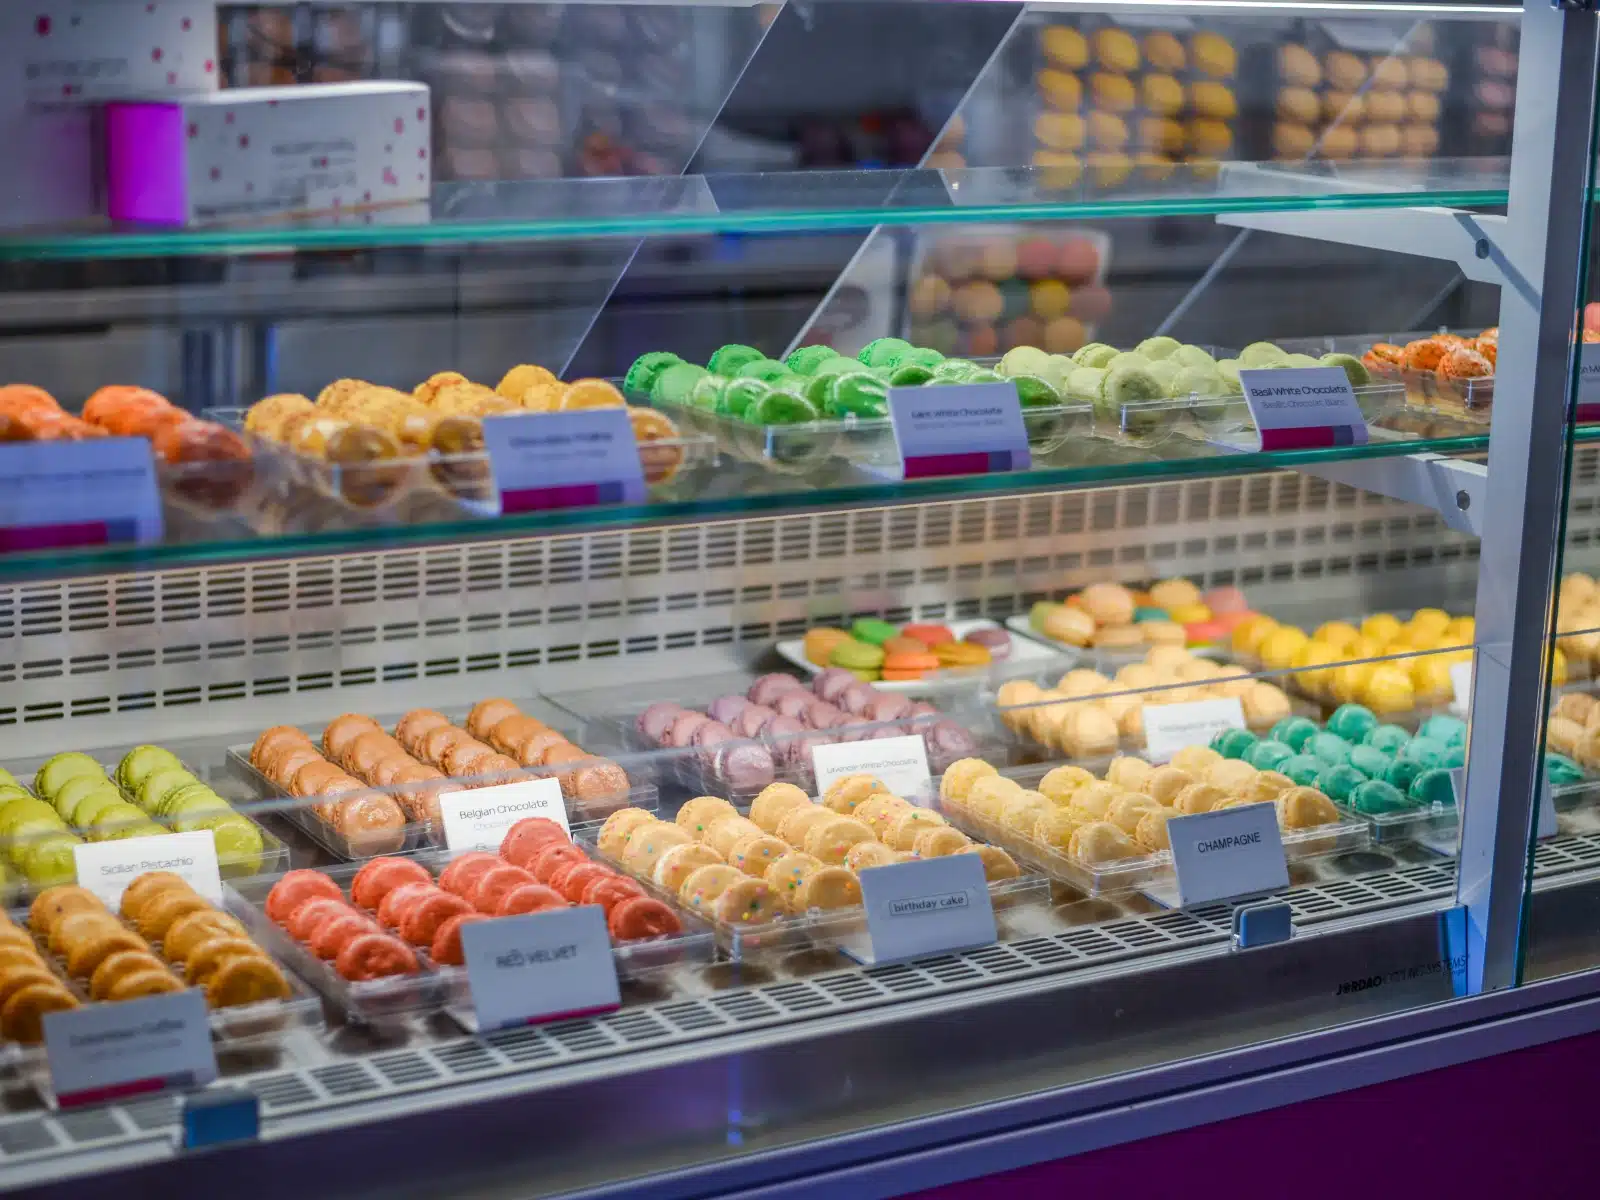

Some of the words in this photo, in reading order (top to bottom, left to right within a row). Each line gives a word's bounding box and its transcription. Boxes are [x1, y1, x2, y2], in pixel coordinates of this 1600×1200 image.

[1250, 387, 1272, 397] Basil
[1272, 386, 1301, 397] White
[1302, 384, 1348, 395] Chocolate
[459, 807, 496, 820] Belgian
[497, 798, 549, 815] Chocolate
[1197, 831, 1262, 853] CHAMPAGNE
[100, 861, 138, 876] Sicilian
[141, 855, 194, 870] Pistachio
[893, 899, 937, 913] birthday
[940, 895, 964, 907] cake
[496, 949, 525, 968] RED
[526, 944, 577, 964] VELVET
